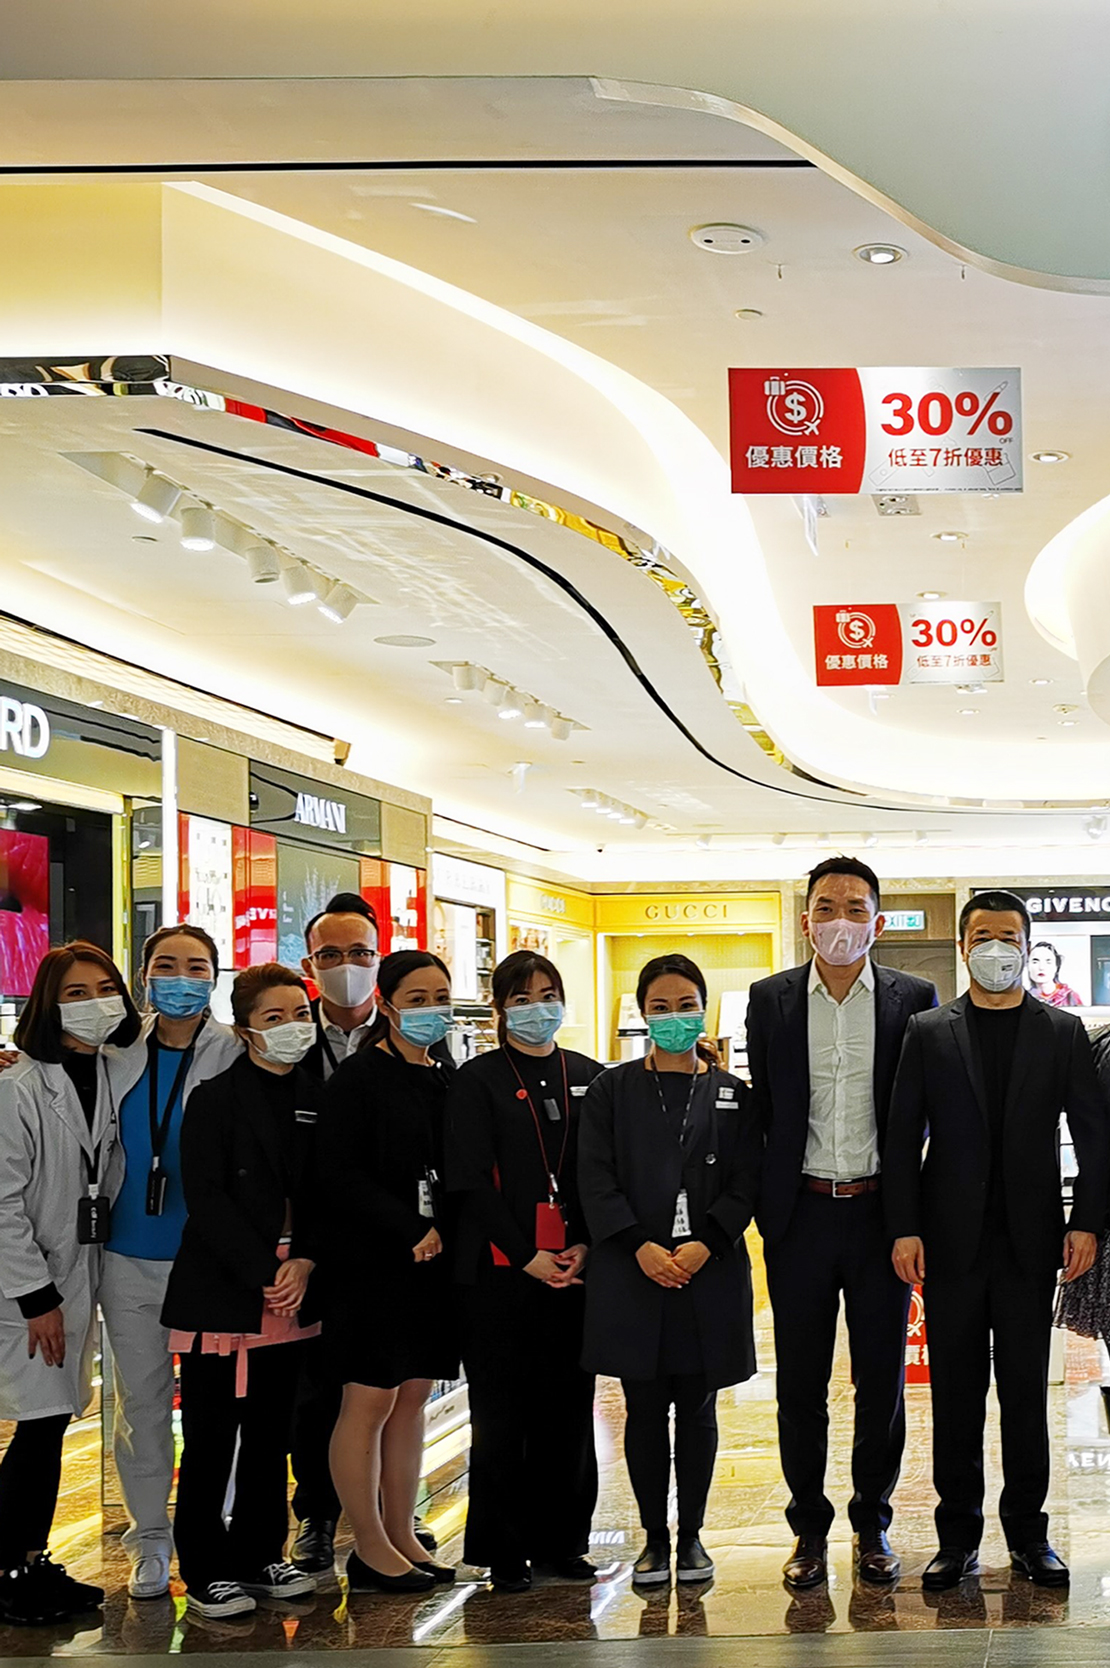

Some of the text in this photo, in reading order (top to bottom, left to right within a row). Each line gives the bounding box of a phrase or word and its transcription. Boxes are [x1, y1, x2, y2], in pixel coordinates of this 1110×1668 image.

[881, 391, 1013, 437] 30%
[745, 445, 843, 469] 優惠價格
[888, 447, 1003, 467] 低至7折優惠
[911, 618, 997, 648] 30%
[825, 654, 888, 670] 優惠價格
[0, 695, 50, 759] RD
[645, 903, 727, 920] GUCCI
